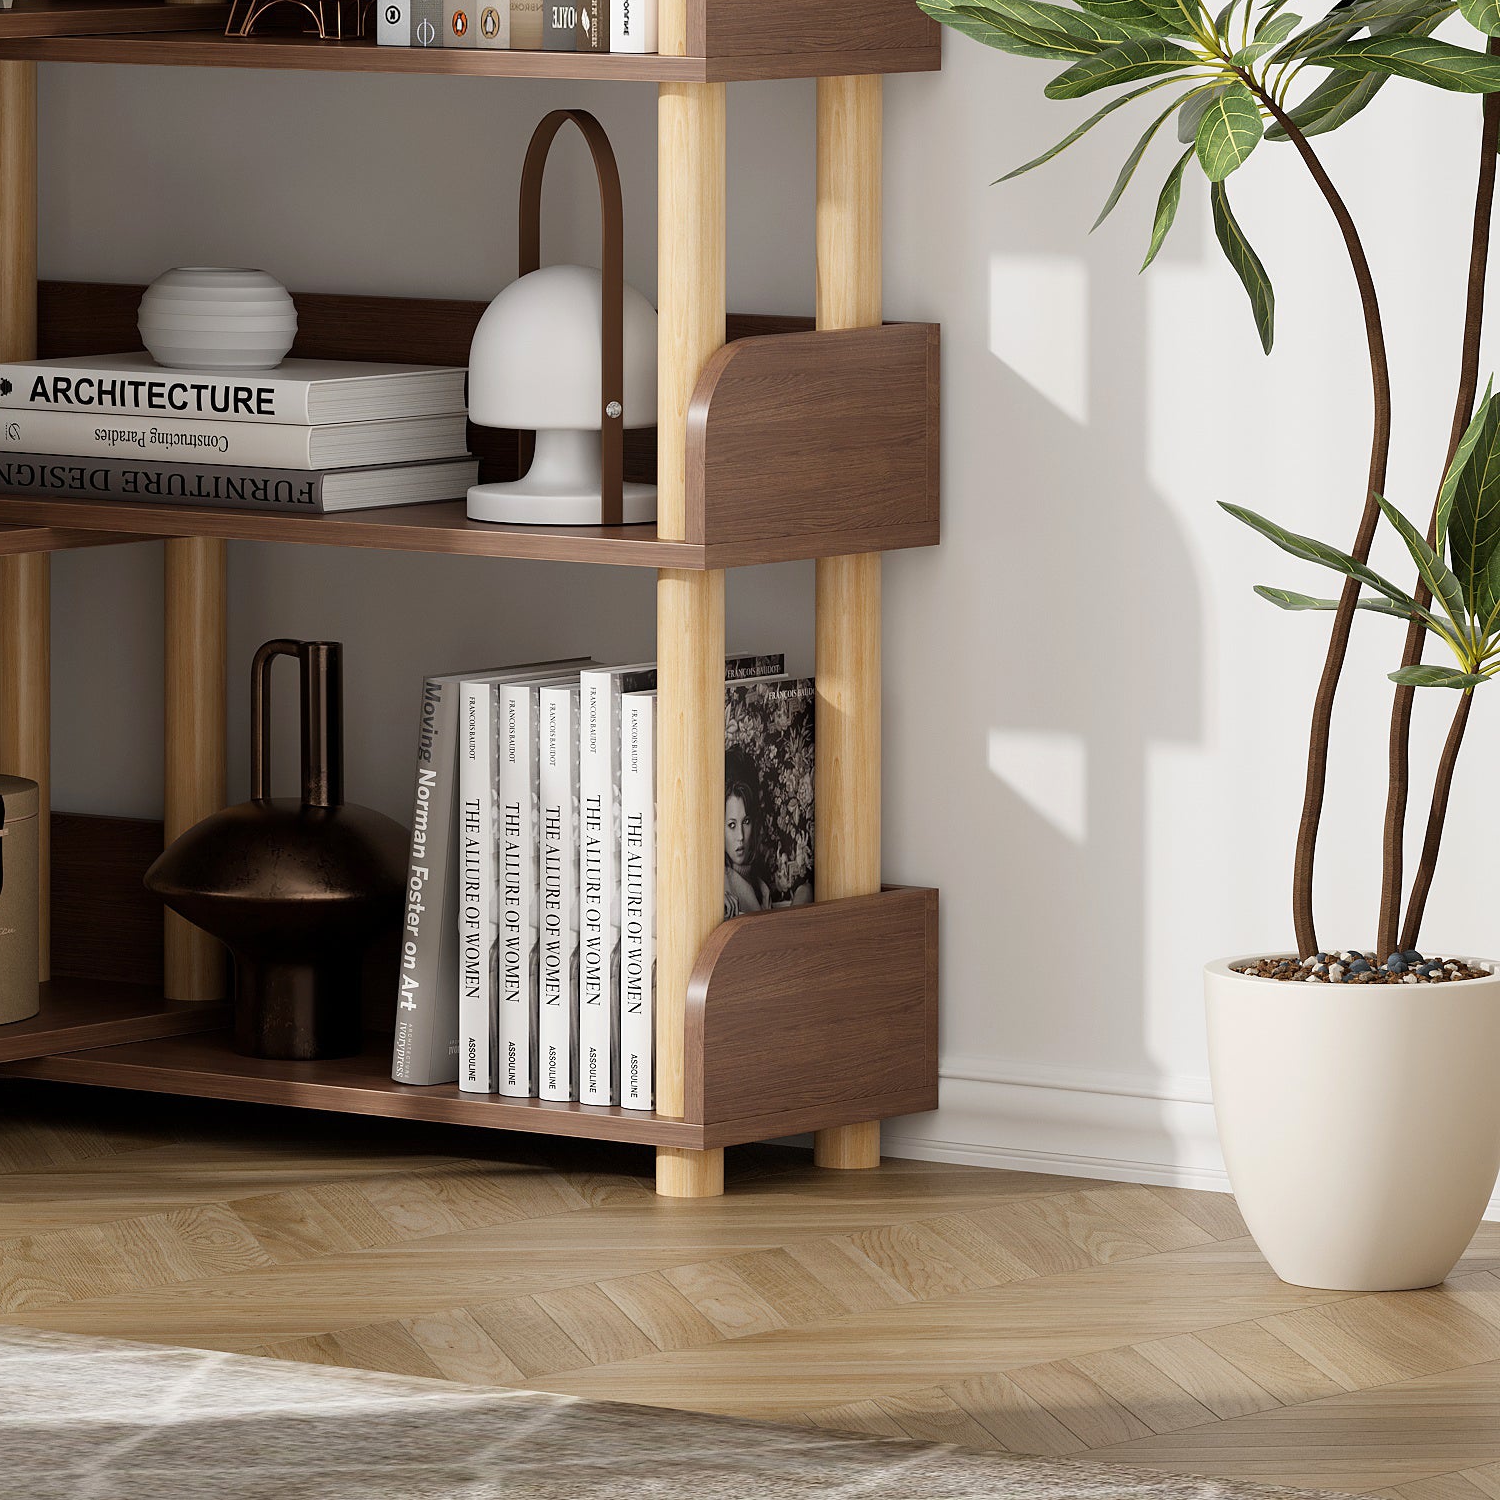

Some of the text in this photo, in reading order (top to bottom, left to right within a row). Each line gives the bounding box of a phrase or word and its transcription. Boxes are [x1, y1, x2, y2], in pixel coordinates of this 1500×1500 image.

[29, 375, 275, 415] ARCHITECTURE
[94, 428, 229, 453] Constructing Paradies
[121, 471, 315, 505] FURNITURE
[468, 731, 476, 760] BAUDOT
[508, 734, 516, 764] BAUDOT
[589, 723, 597, 754] BAUDOT
[400, 681, 442, 1012] Moving Norman Foster on Art
[465, 798, 480, 999] THE ALLURE OF WOMEN
[505, 801, 520, 1003] THE ALLURE OF WOMEN
[545, 805, 561, 1006] THE ALLURE OF WOMEN
[585, 794, 601, 1006] THE ALLURE OF WOMEN
[627, 812, 643, 1015] THE ALLURE OF WOMEN
[405, 1023, 413, 1079] ARCHITECTURE
[468, 1037, 476, 1081] ASSOULINE
[508, 1041, 516, 1085] ASSOULINE
[548, 1045, 556, 1089] ASSOULINE
[588, 1046, 597, 1094] ASSOULINE
[630, 1053, 638, 1098] ASSOULINE
